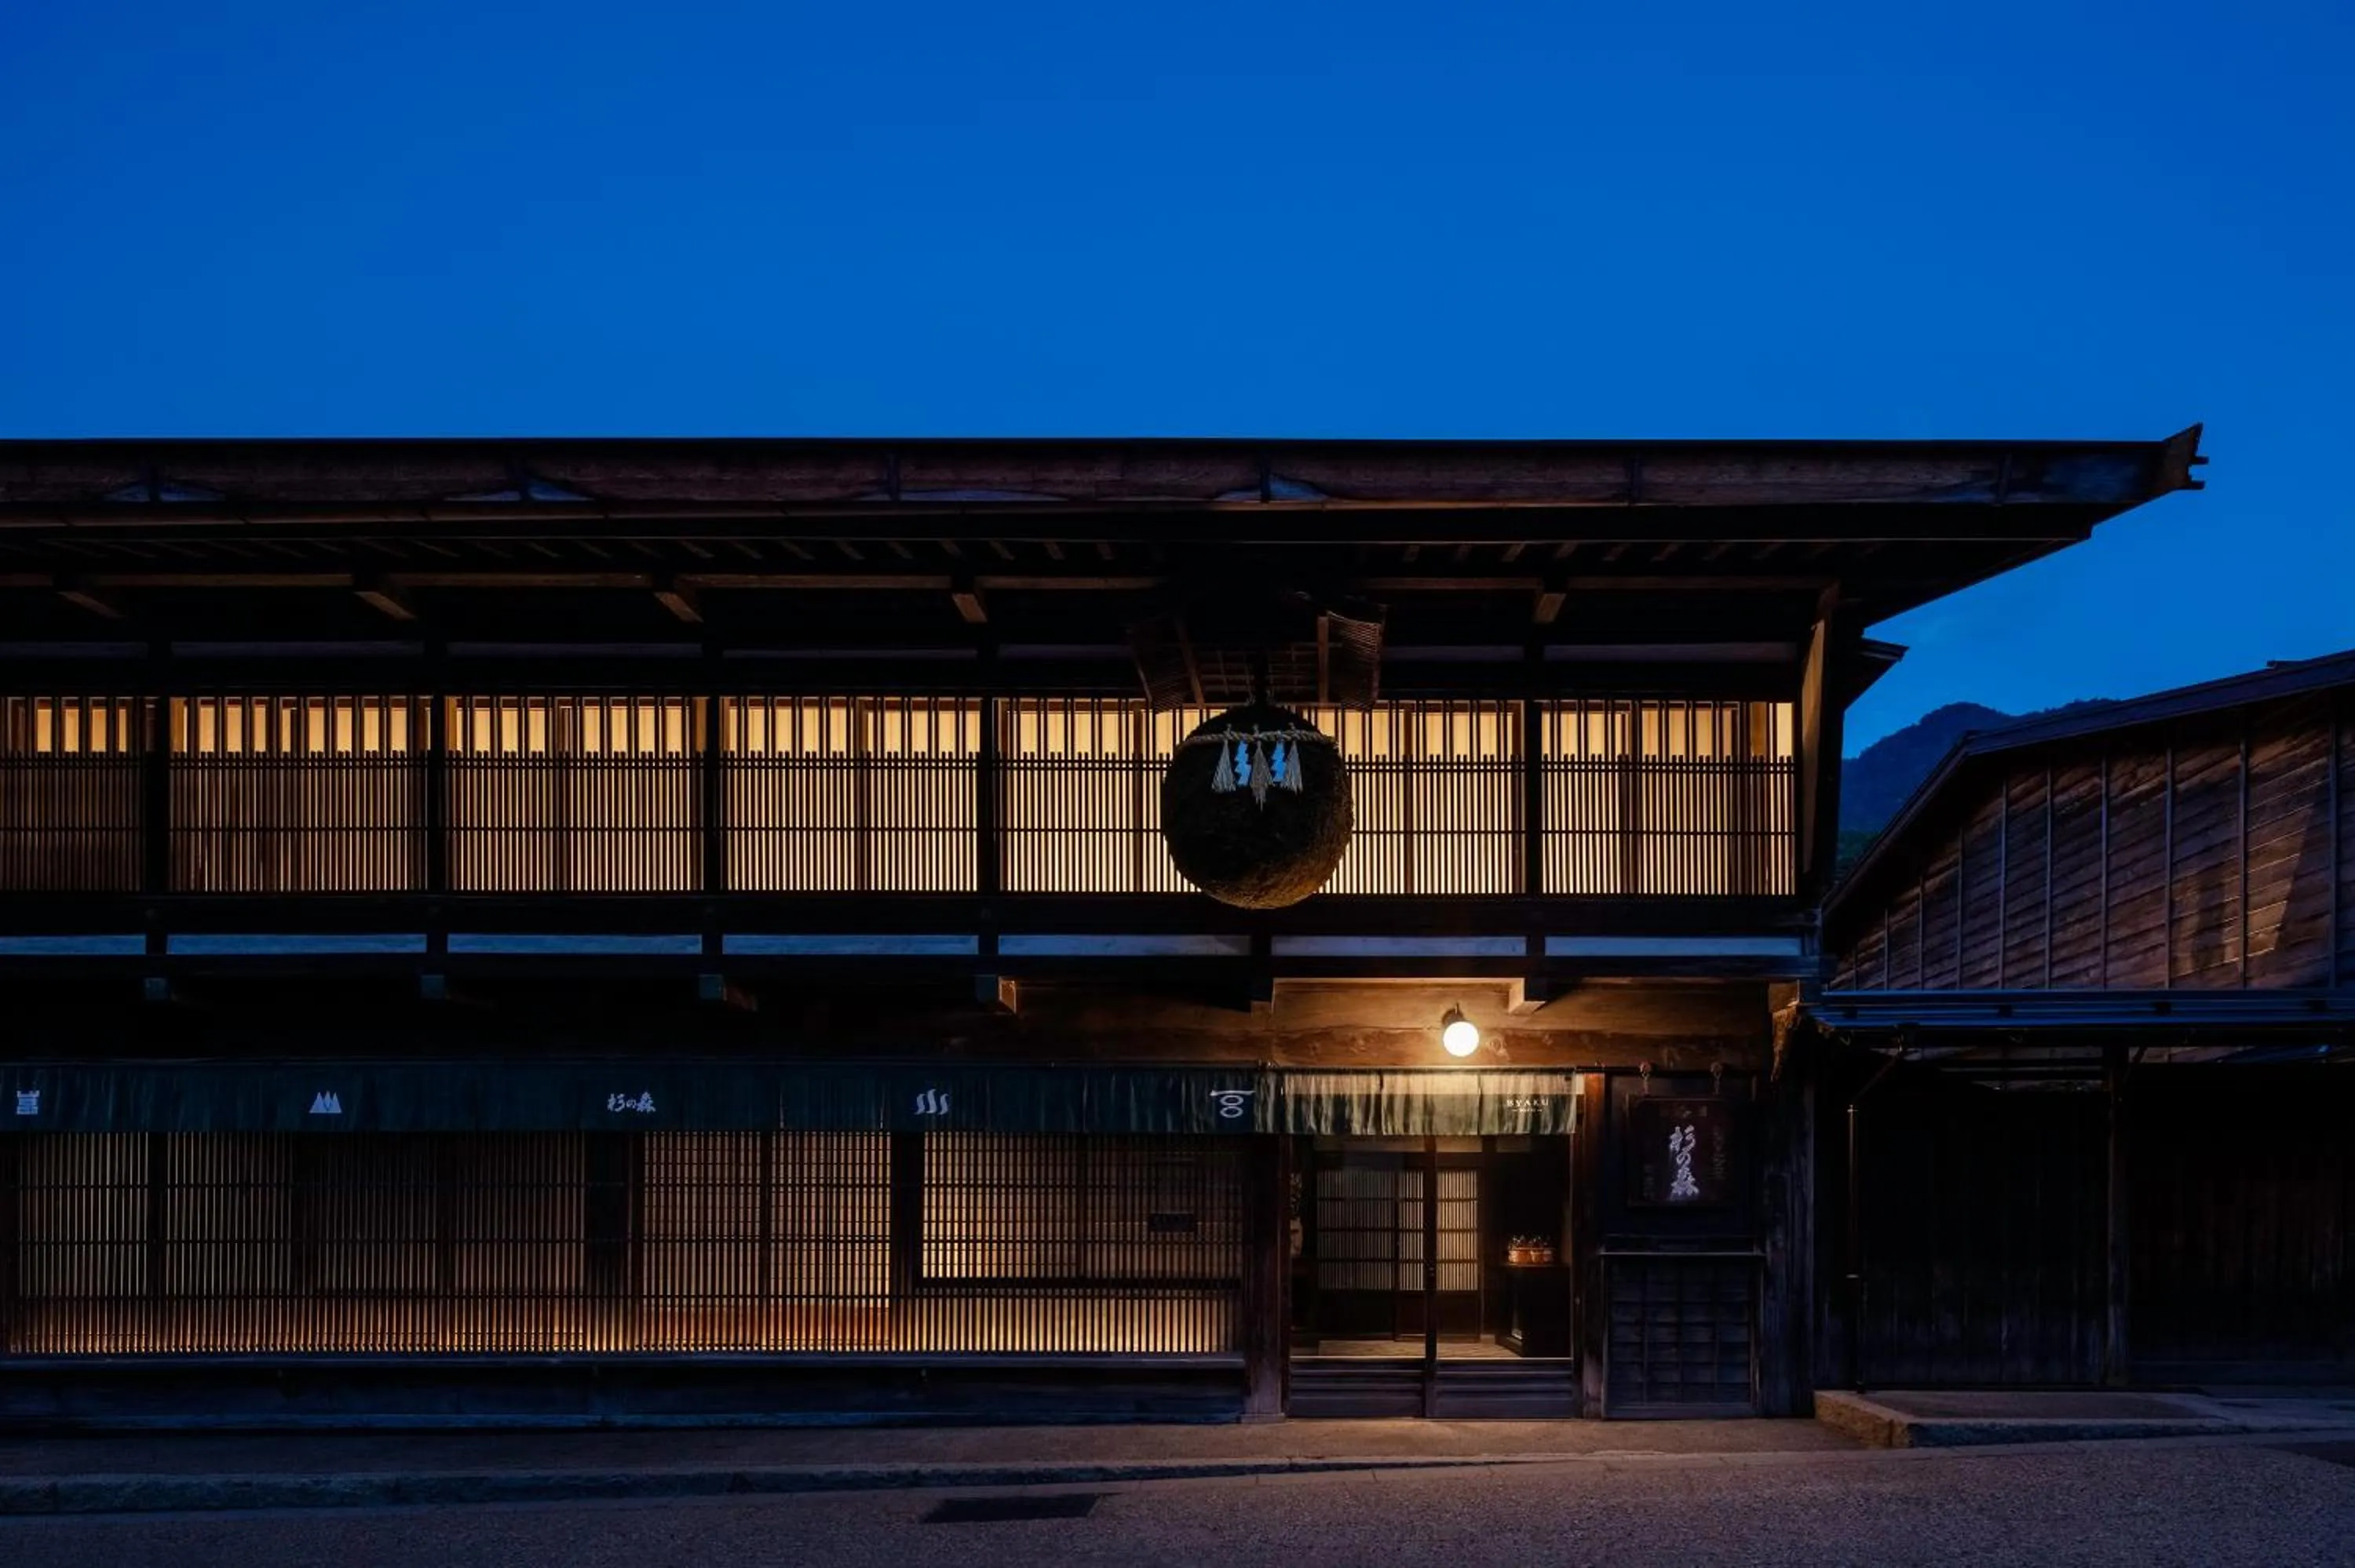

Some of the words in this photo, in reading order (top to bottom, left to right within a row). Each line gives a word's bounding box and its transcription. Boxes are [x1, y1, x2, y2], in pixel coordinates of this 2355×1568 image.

[607, 1091, 656, 1114] 杉の森
[1506, 1099, 1548, 1107] BYAKU
[1668, 1125, 1700, 1198] 杉の森
